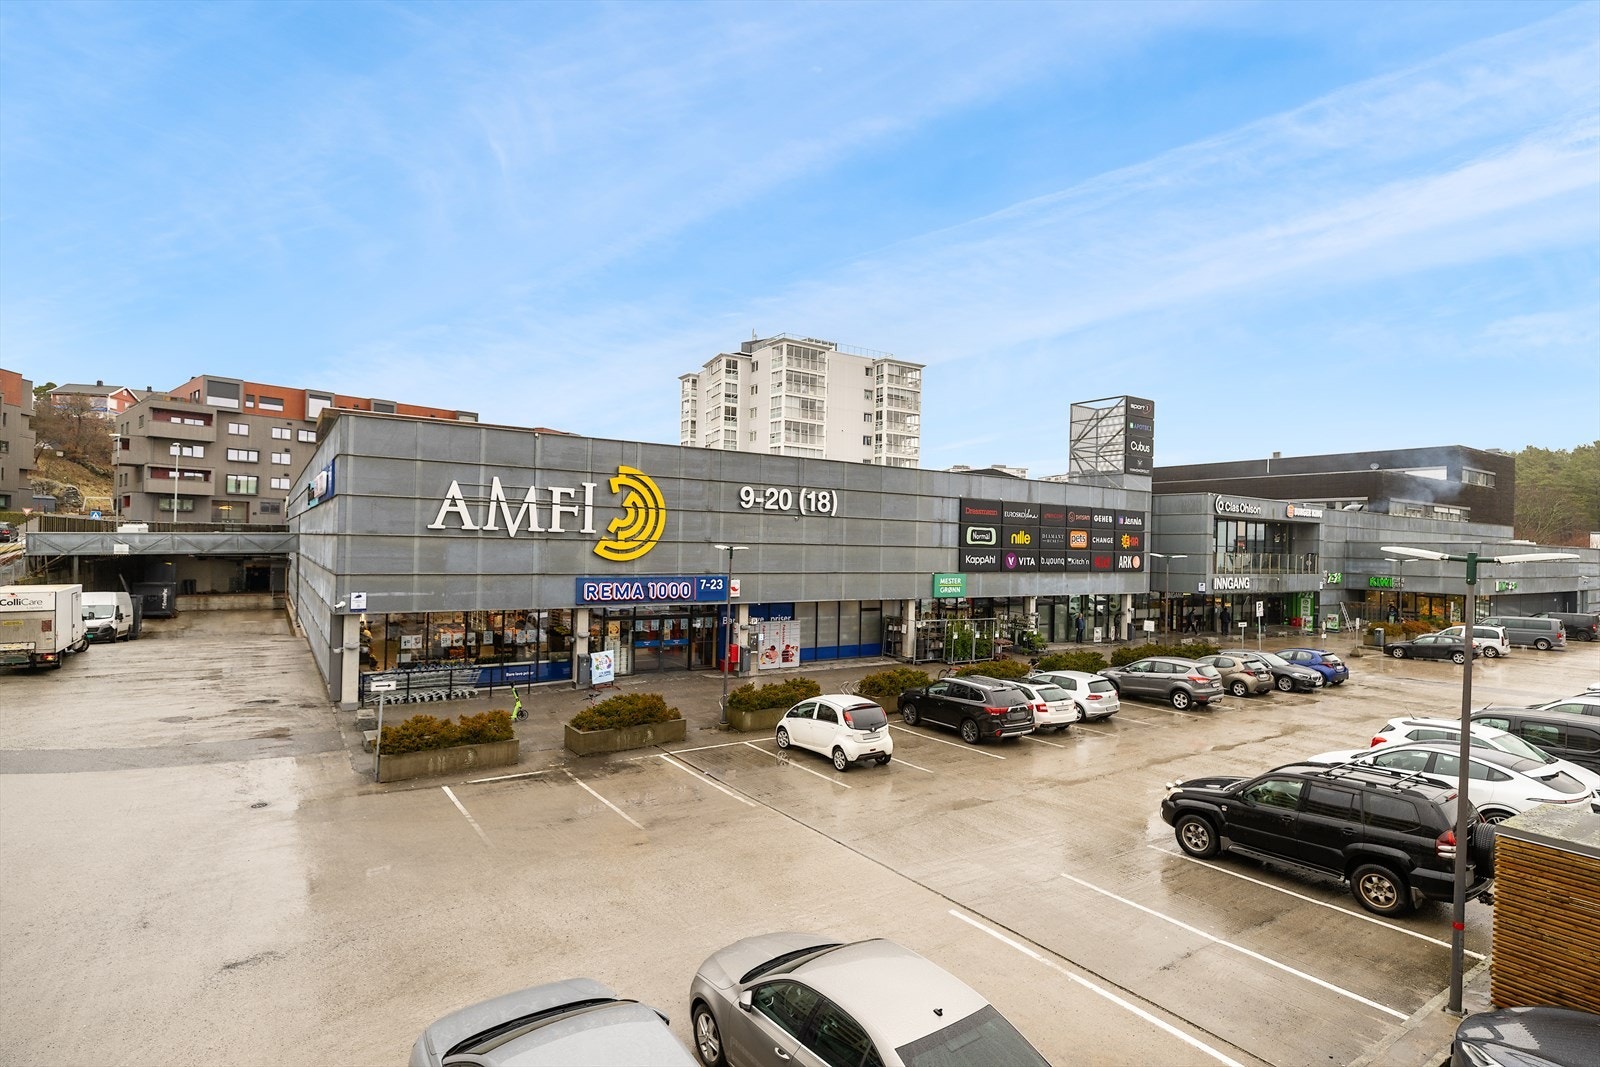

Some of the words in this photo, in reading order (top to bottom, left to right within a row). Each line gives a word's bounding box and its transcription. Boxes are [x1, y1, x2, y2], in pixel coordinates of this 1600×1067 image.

[1130, 441, 1150, 453] Cubus
[427, 476, 597, 537] AMFI
[739, 486, 793, 511] 9-20
[799, 487, 838, 517] (18)
[1225, 501, 1239, 512] Clas
[1240, 502, 1261, 515] Ohlson
[1093, 514, 1113, 523] GEHEB
[972, 531, 991, 540] Normal
[1011, 530, 1031, 544] nille
[1092, 536, 1113, 544] CHANGE
[965, 555, 996, 566] KappAhl
[1018, 557, 1036, 566] VITA
[1118, 555, 1133, 569] ARK
[939, 577, 962, 585] MESTER
[1213, 577, 1250, 590] INNGANG
[1369, 576, 1393, 588] KIWI
[584, 582, 645, 601] REMA
[647, 581, 692, 600] 1000
[700, 579, 724, 590] 7-23
[939, 585, 961, 594] GRØNN
[0, 598, 43, 607] ColliCare
